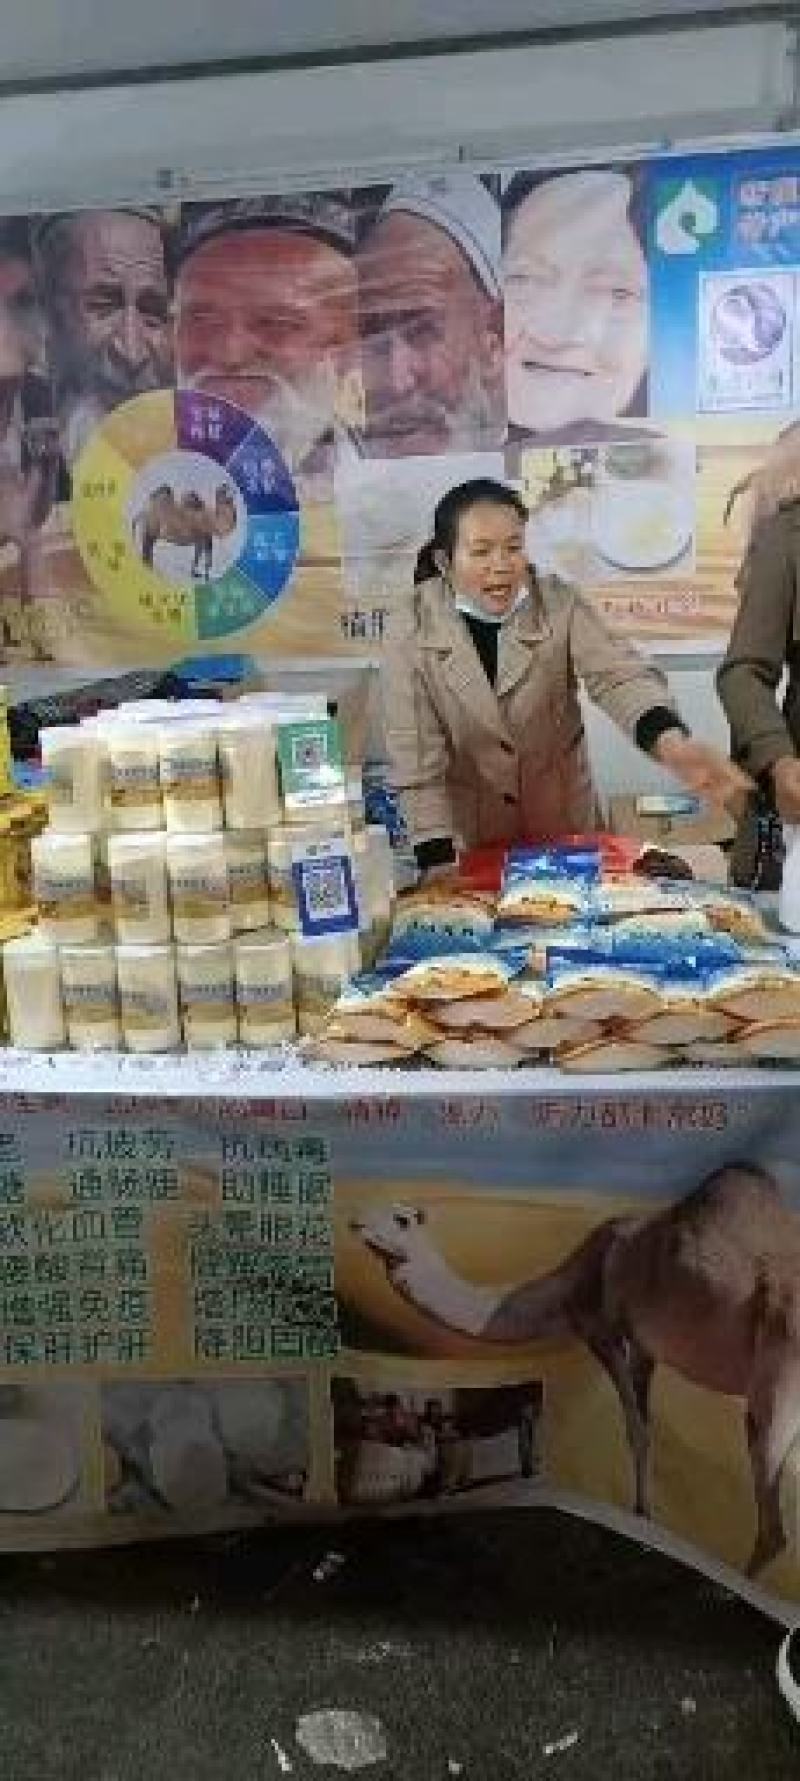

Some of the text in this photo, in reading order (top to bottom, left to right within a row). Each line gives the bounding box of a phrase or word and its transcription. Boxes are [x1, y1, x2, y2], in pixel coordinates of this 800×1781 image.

[62, 1130, 175, 1159] 抗疲劳
[221, 1134, 329, 1163] 抗病毒
[221, 1169, 331, 1205] 助睡眠
[186, 1208, 331, 1247] 头晕眼花
[0, 1288, 153, 1327] 增强免疫
[5, 1326, 342, 1364] 保肝护肝 降胆固醇
